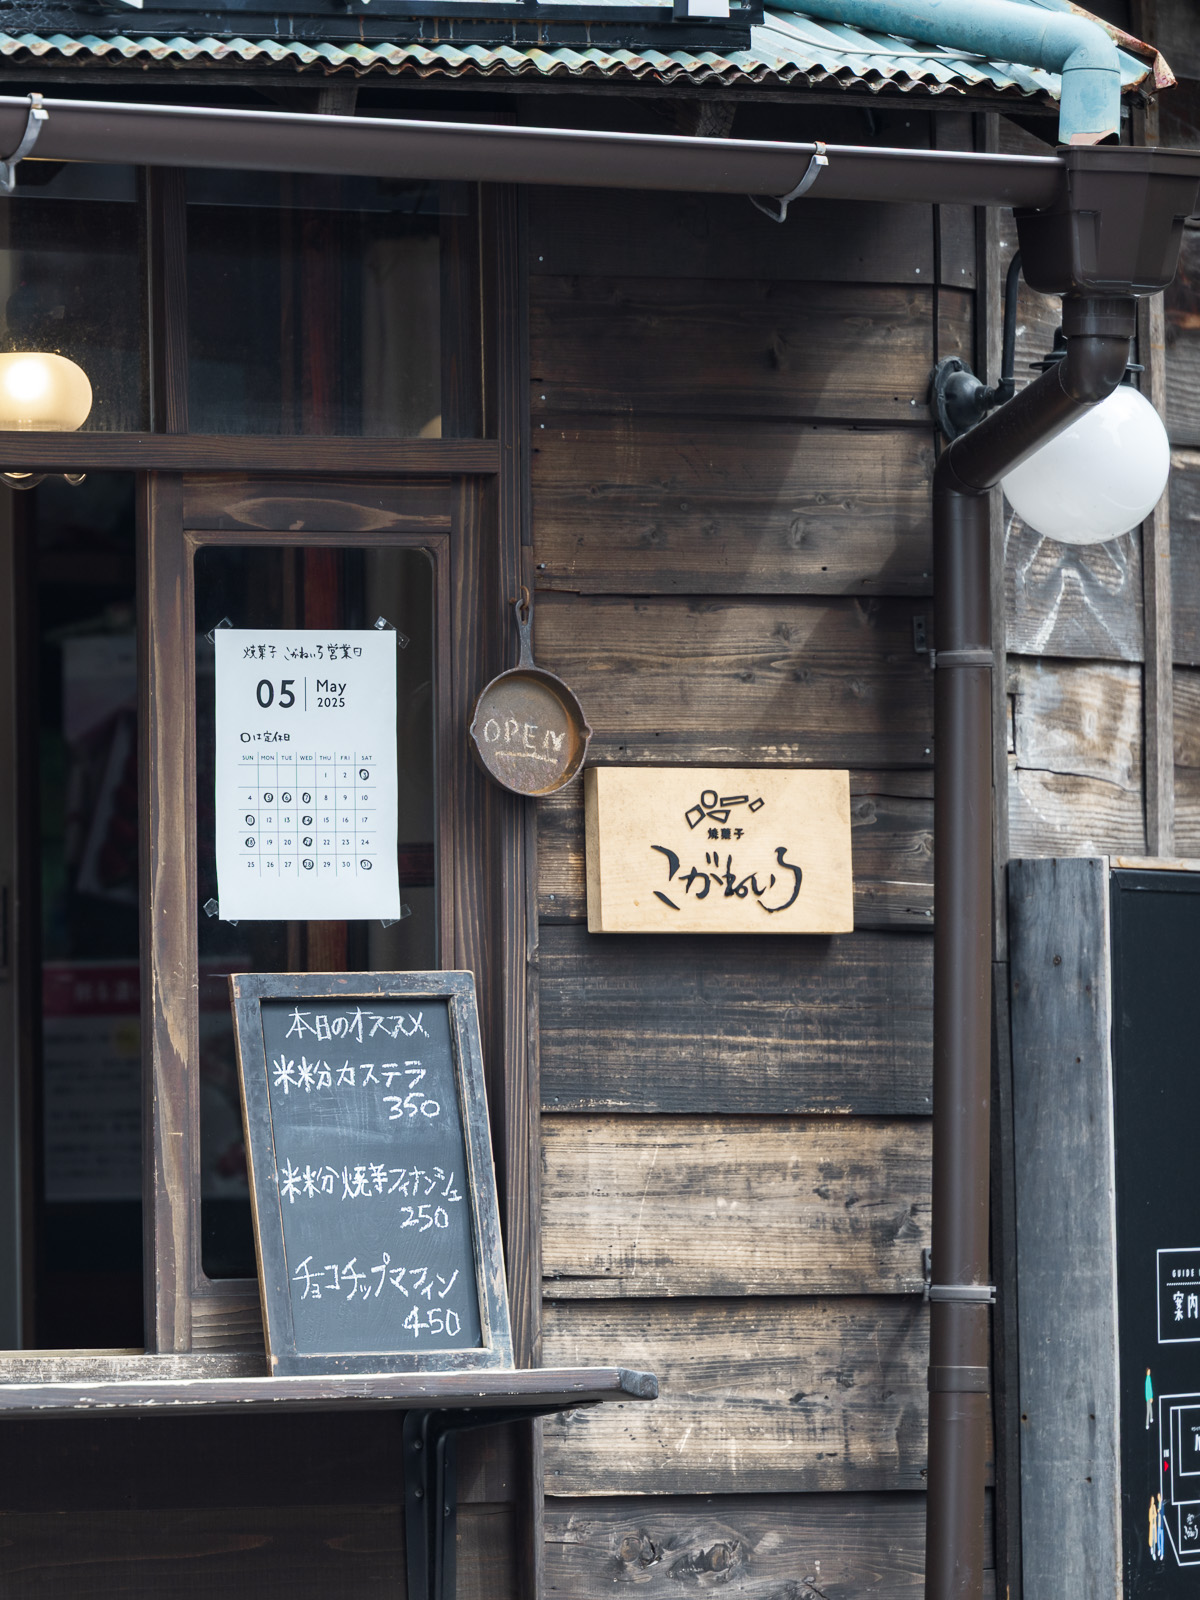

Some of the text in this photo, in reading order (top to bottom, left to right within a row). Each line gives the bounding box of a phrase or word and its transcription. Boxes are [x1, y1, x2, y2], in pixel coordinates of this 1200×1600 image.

[257, 679, 295, 708] 05
[317, 680, 346, 696] May
[318, 698, 345, 707] 2025
[483, 718, 565, 752] OPEN
[650, 845, 803, 913] こがねいろ
[286, 1006, 430, 1043] 本日のオススメ
[273, 1054, 426, 1094] 米粉カステラ
[383, 1092, 440, 1120] 350
[400, 1204, 448, 1232] 250
[292, 1252, 459, 1300] チョコチップマフィン
[1172, 1268, 1194, 1278] GUIDE
[1173, 1291, 1198, 1321] 案内
[402, 1305, 461, 1338] 450
